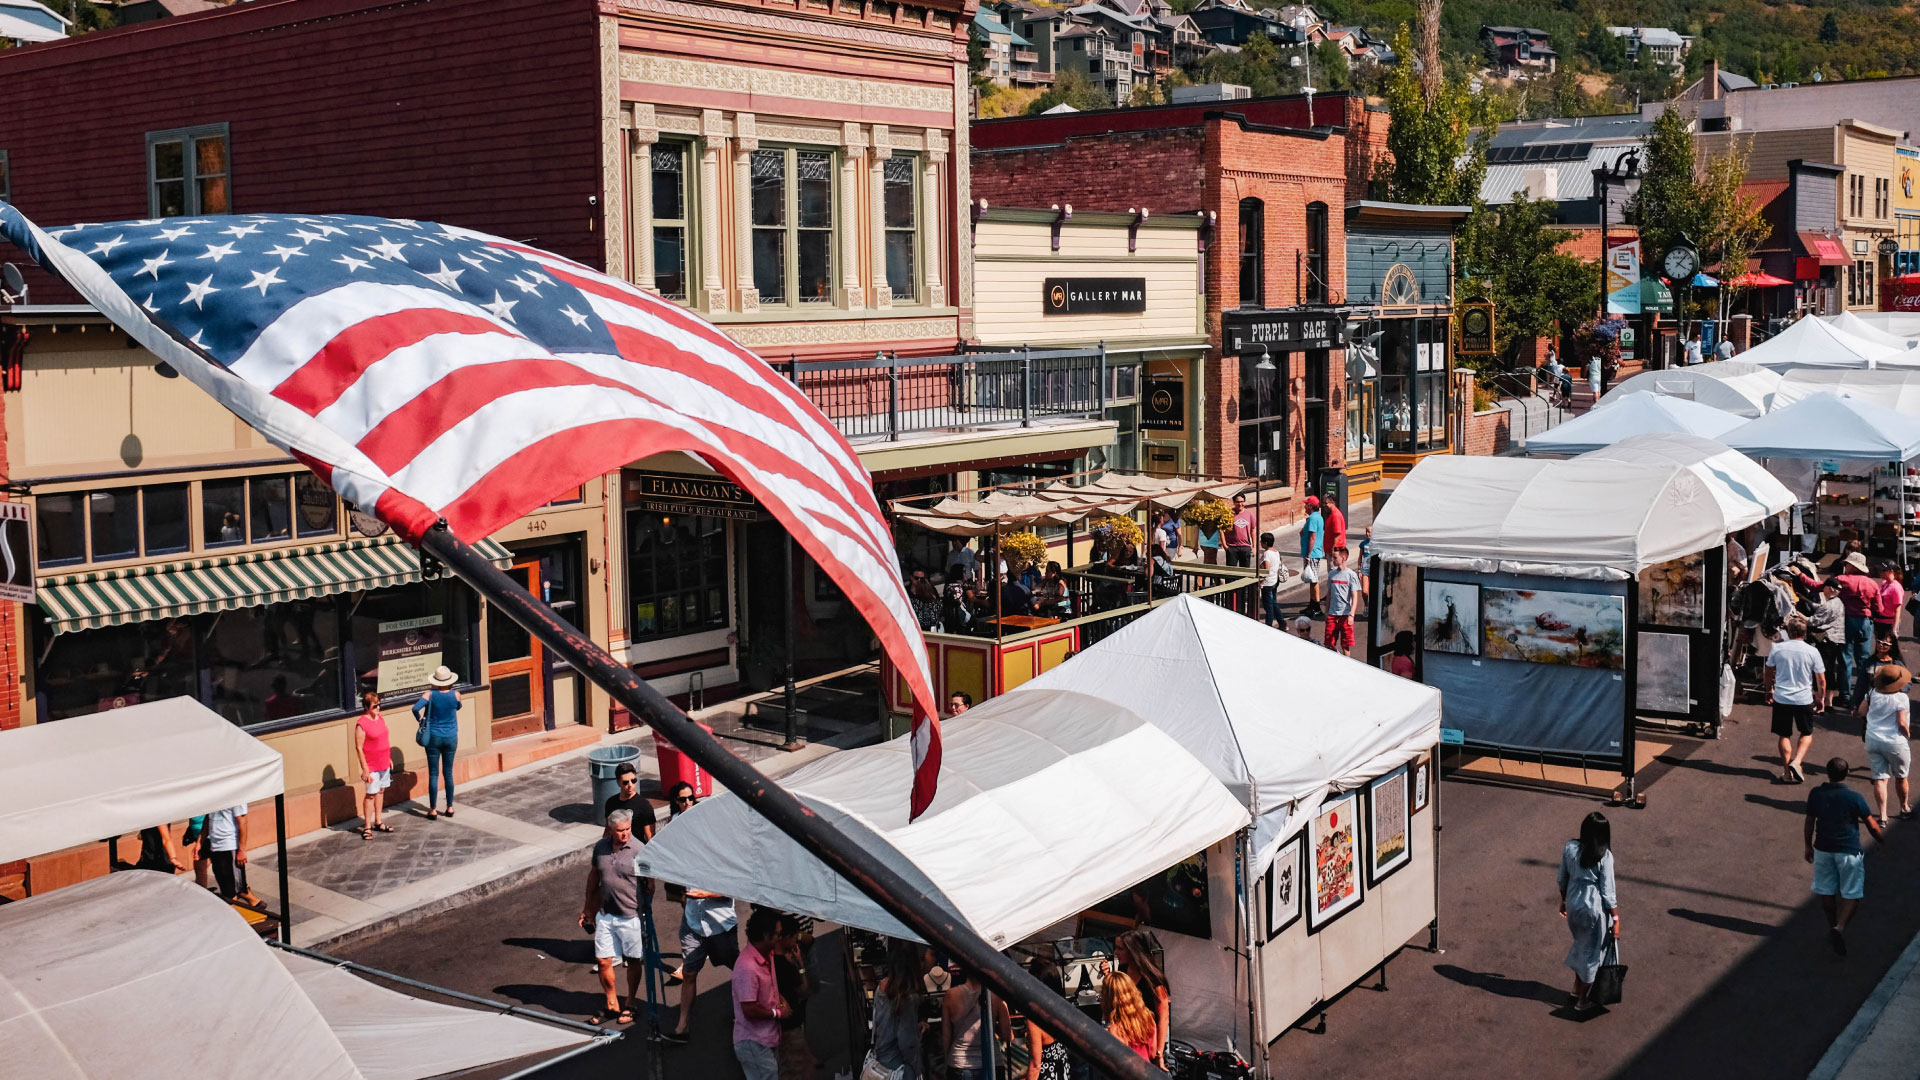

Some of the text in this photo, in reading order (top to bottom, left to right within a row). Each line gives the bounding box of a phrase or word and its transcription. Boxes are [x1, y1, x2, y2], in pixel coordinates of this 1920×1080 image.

[1070, 290, 1142, 301] GALLERY MAR
[1251, 320, 1327, 342] PURPLE SAGE
[653, 479, 742, 500] FLANAGAN'S
[646, 502, 668, 511] IRISH
[671, 504, 686, 513] PUB
[696, 507, 750, 518] RESTAURANT
[527, 519, 547, 532] 440
[400, 620, 414, 628] SALE
[419, 617, 437, 625] LEASE
[382, 642, 440, 656] BERKSHIRE HATHAWAY
